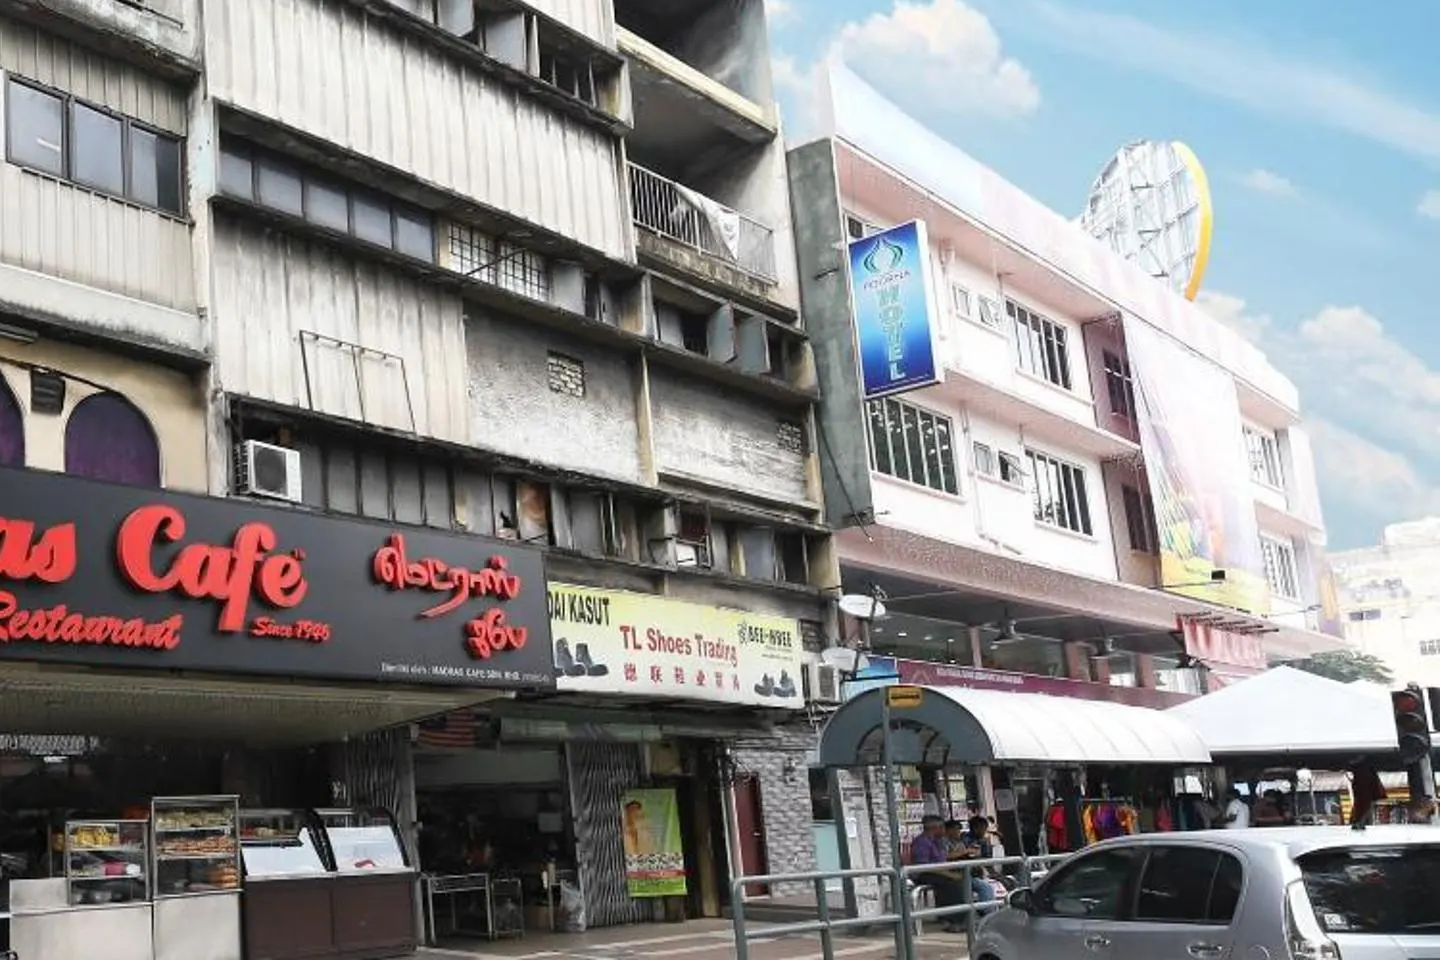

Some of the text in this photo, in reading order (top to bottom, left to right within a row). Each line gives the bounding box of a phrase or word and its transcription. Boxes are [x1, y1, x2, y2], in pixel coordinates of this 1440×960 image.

[568, 593, 610, 626] KASUT
[251, 616, 293, 638] Since
[620, 624, 739, 668] TL Shoes Trading
